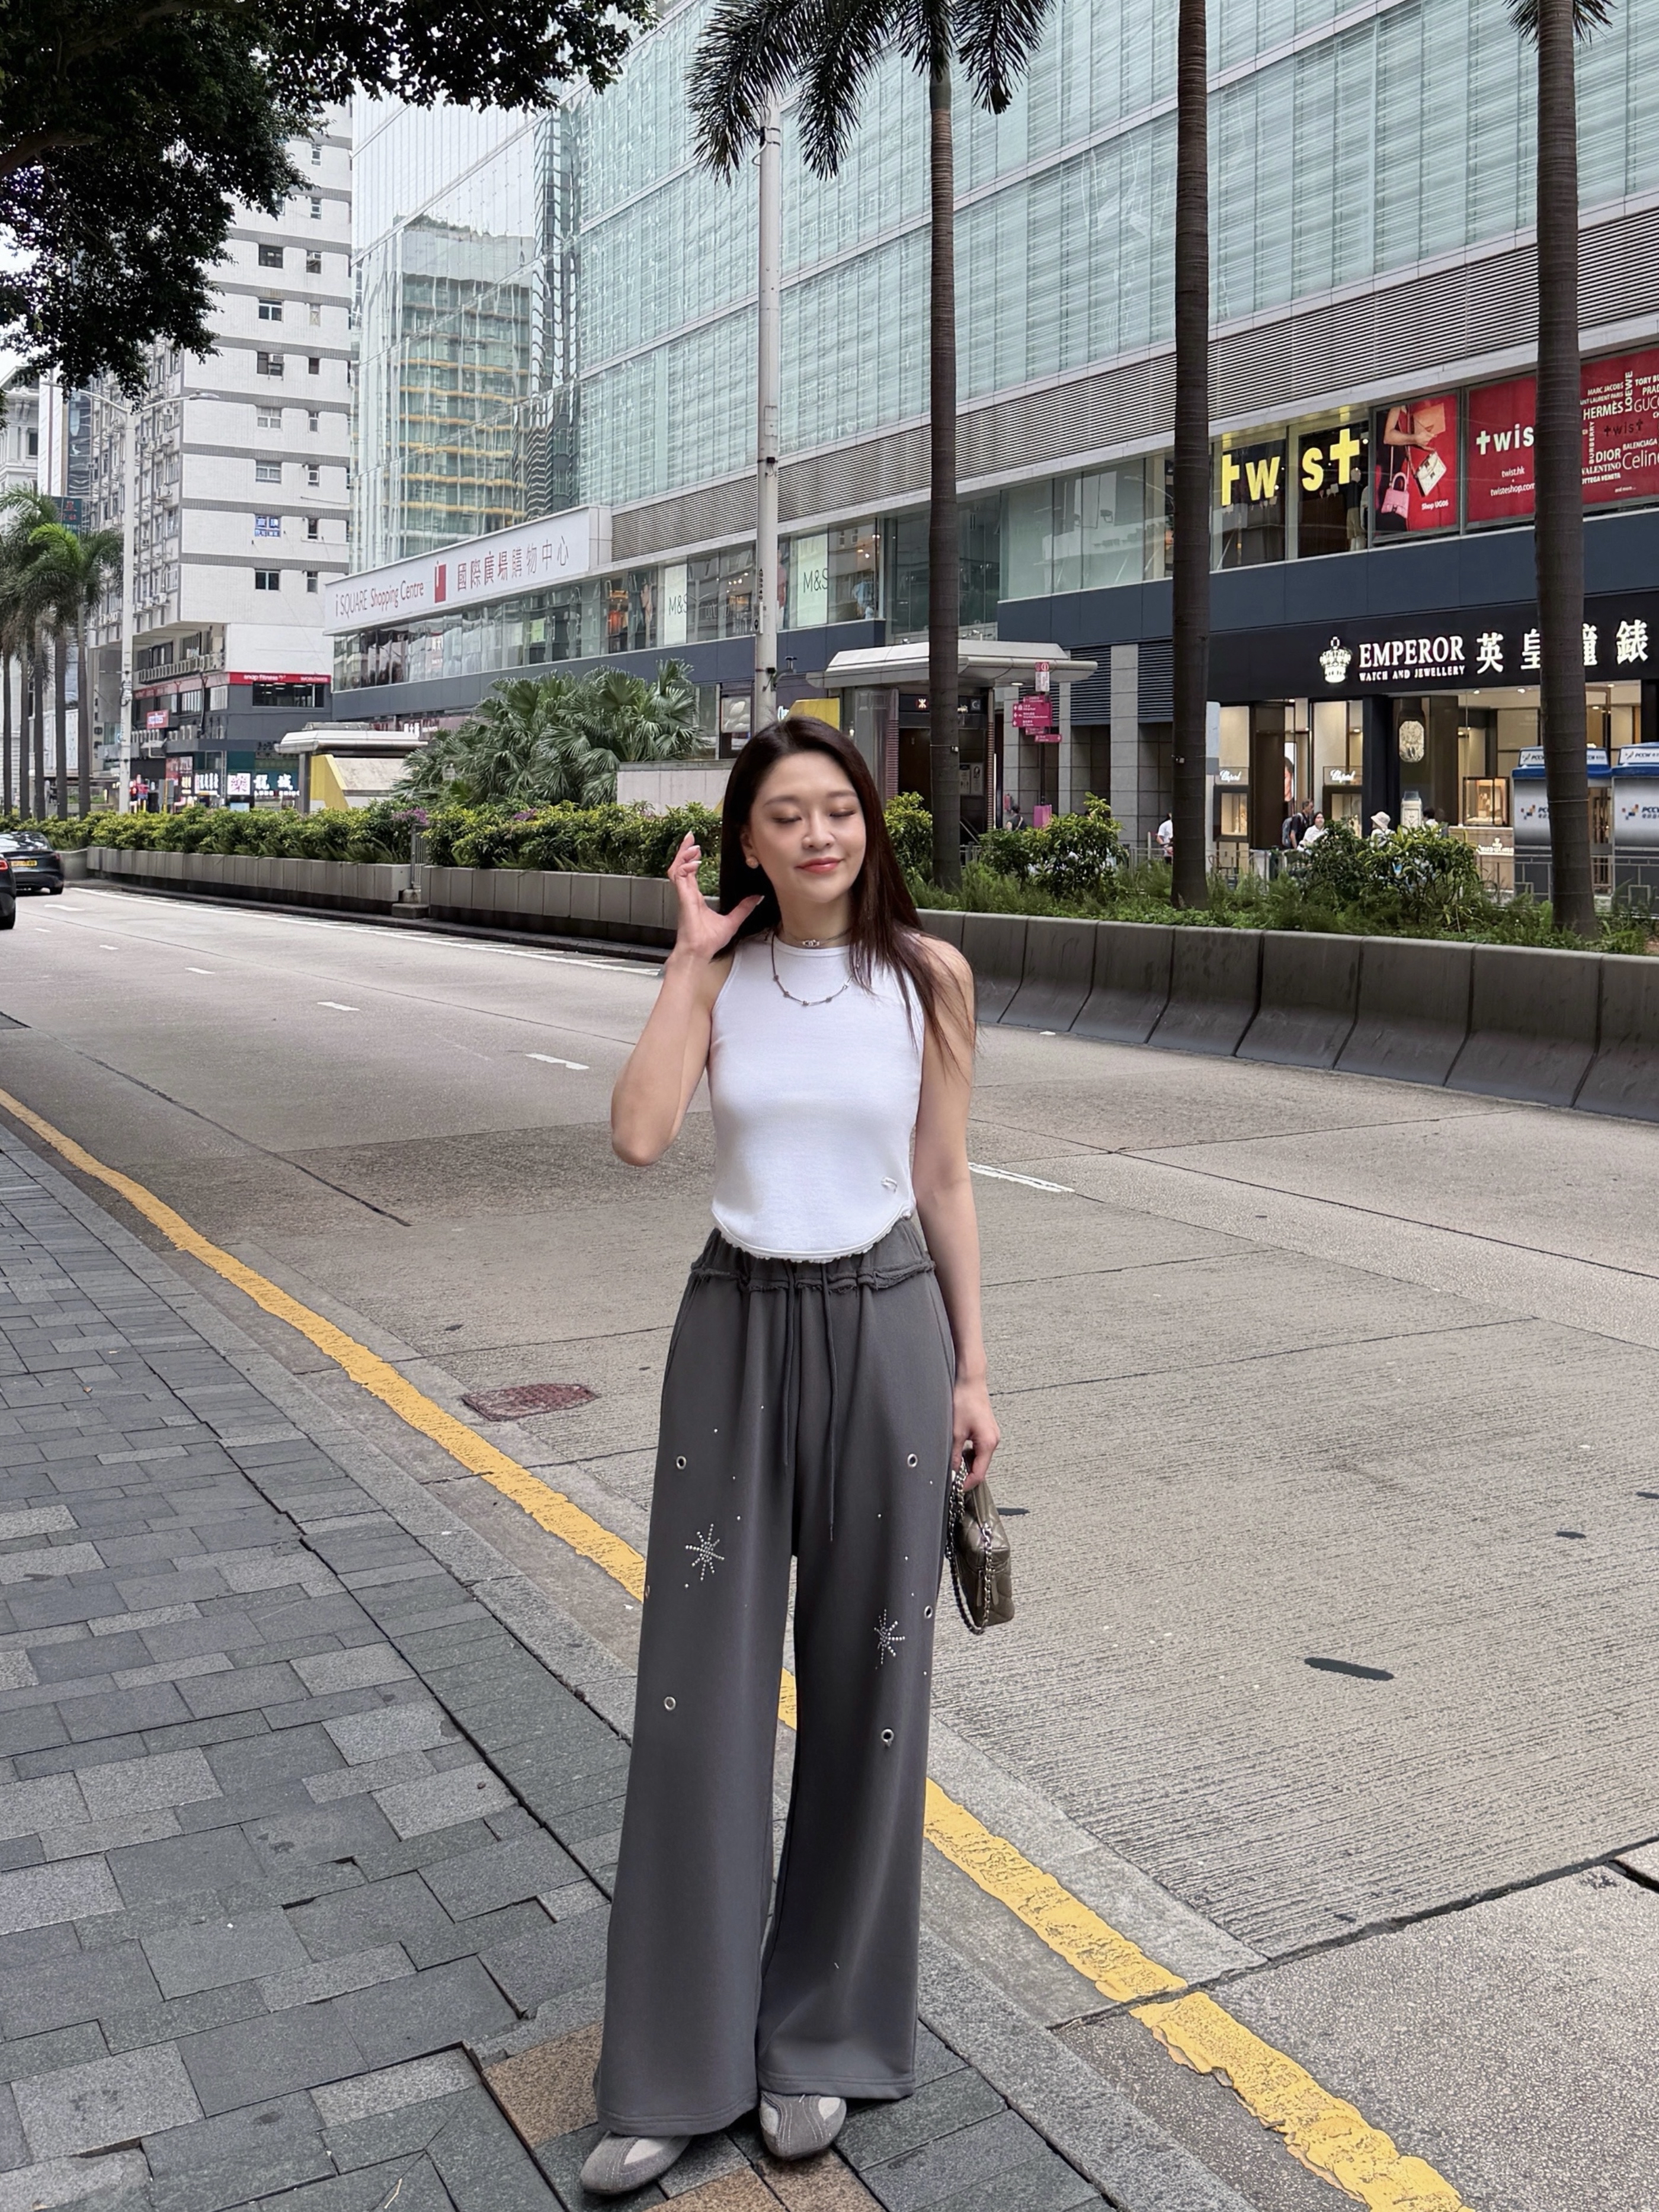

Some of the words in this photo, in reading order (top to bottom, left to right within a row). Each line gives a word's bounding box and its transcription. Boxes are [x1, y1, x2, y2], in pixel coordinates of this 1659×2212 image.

[1587, 386, 1603, 396] MARC
[1603, 381, 1624, 393] JACOBS
[1635, 376, 1651, 387] TORY
[1589, 393, 1610, 404] LAURENT
[1610, 391, 1624, 399] PARIS
[1625, 371, 1633, 412] LOEWE
[1583, 400, 1623, 421] HERMÈS
[1634, 395, 1659, 413] GUC
[1603, 418, 1644, 437] twist
[1476, 423, 1535, 456] twis
[1622, 438, 1658, 451] BALENCIAGA
[1596, 447, 1621, 463] DIOR
[1222, 428, 1360, 506] twst
[1501, 465, 1526, 478] twist.hk
[1581, 461, 1622, 476] VALENTINO
[1601, 472, 1621, 482] VENETA
[370, 585, 399, 612] Shopping
[400, 580, 424, 601] Centre
[1359, 635, 1466, 668] EMPEROR
[1359, 670, 1388, 682] WATCH
[1392, 668, 1411, 680] AND
[1414, 665, 1466, 679] JEWELLERY
